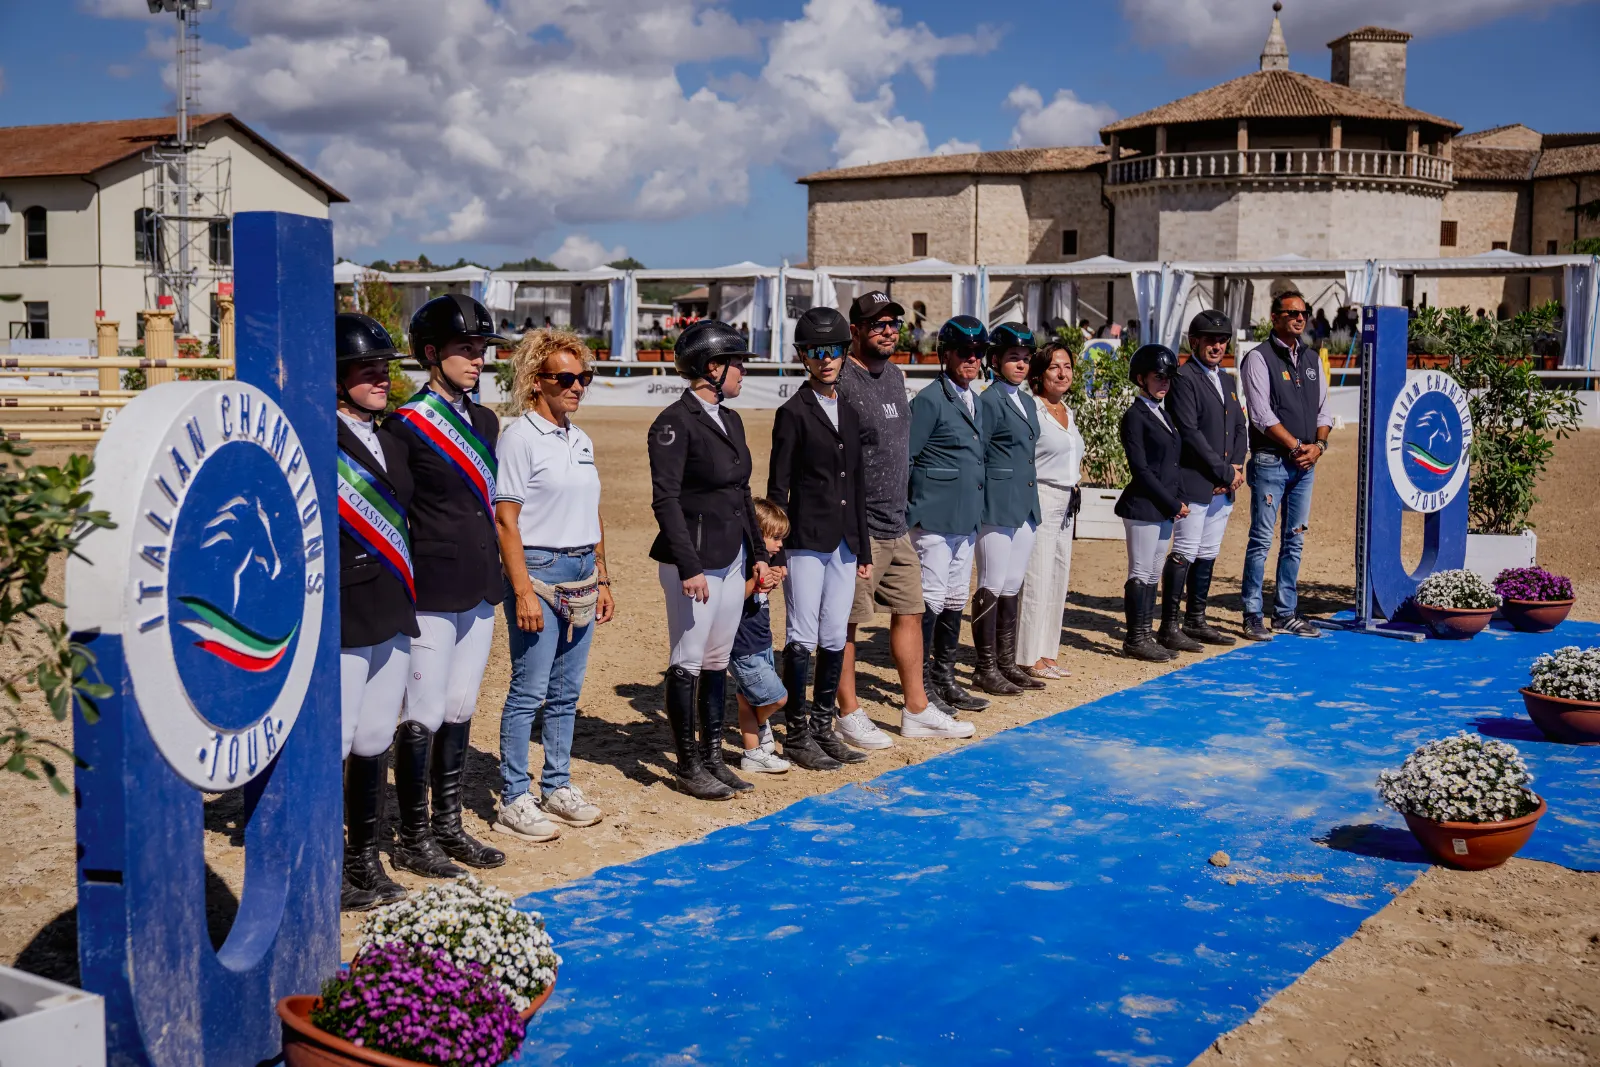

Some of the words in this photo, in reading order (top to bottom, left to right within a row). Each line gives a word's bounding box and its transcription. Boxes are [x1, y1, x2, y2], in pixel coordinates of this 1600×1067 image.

[1391, 382, 1420, 451] ITALIAN
[1427, 375, 1471, 450] CHAMPIONS
[448, 428, 496, 496] CLASSIFICATO
[137, 415, 206, 633] ITALIAN
[220, 393, 325, 594] CHAMPIONS
[1415, 490, 1445, 511] TOUR
[208, 716, 278, 783] TOUR
